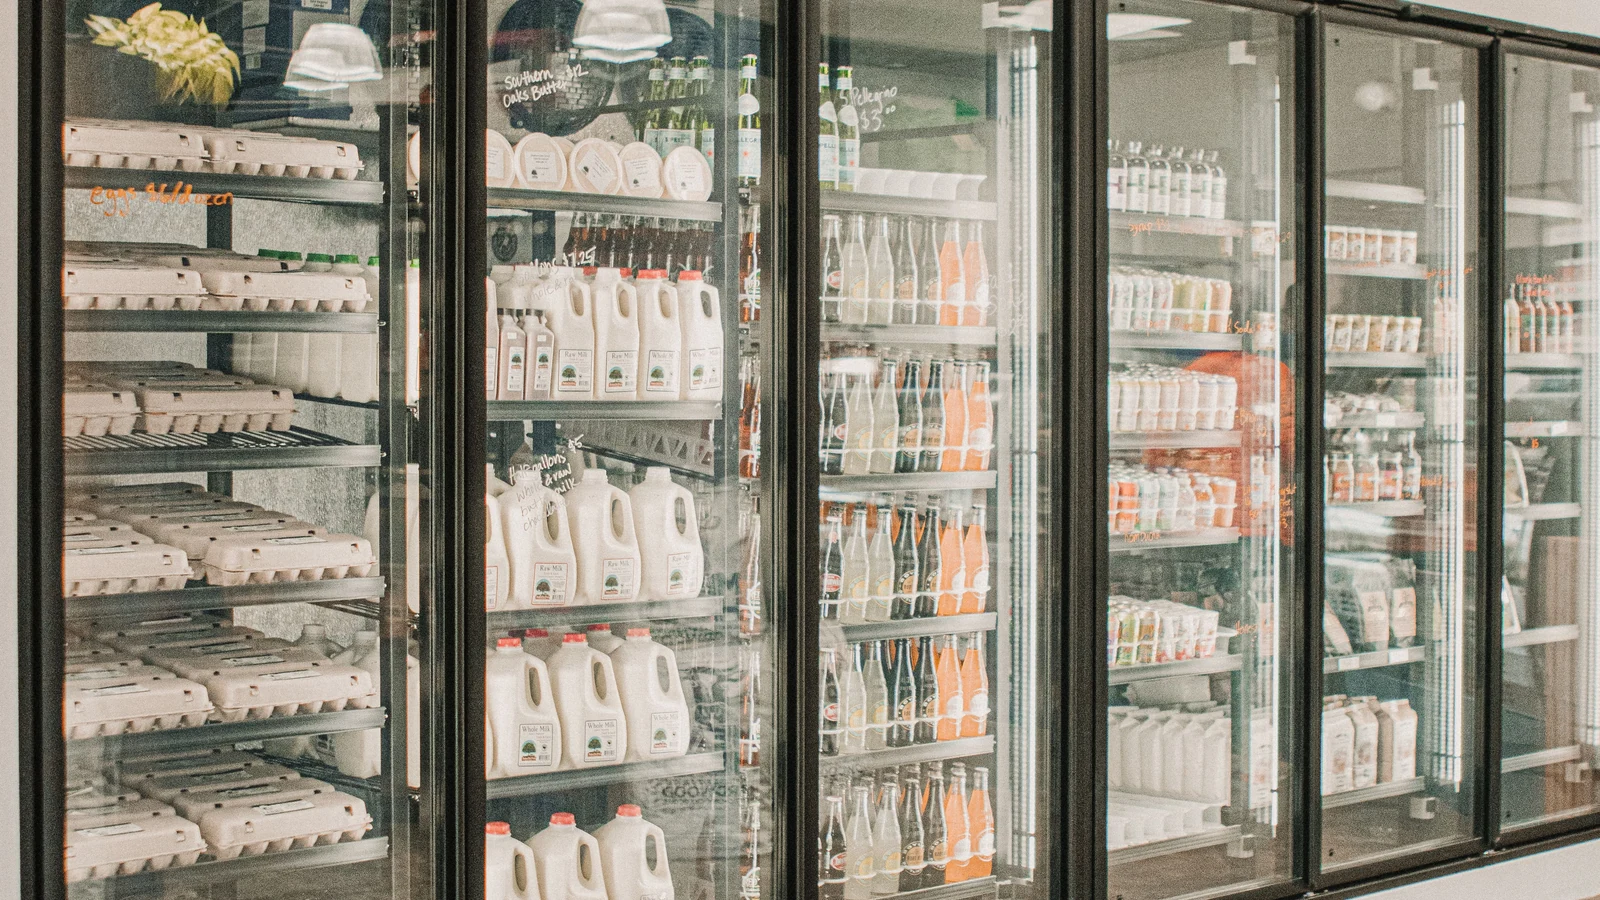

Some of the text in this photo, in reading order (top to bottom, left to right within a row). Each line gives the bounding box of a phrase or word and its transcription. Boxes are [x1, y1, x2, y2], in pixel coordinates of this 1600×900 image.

[504, 63, 589, 90] Southern $12
[503, 79, 568, 108] Oaks Butter
[90, 186, 137, 218] eggs
[564, 350, 577, 358] Raw
[611, 352, 623, 360] Raw
[552, 462, 572, 482] raw
[539, 564, 563, 572] Raw Milk
[653, 713, 669, 721] Whole
[521, 724, 551, 733] Whole Milk
[587, 720, 615, 730] Whole Milk
